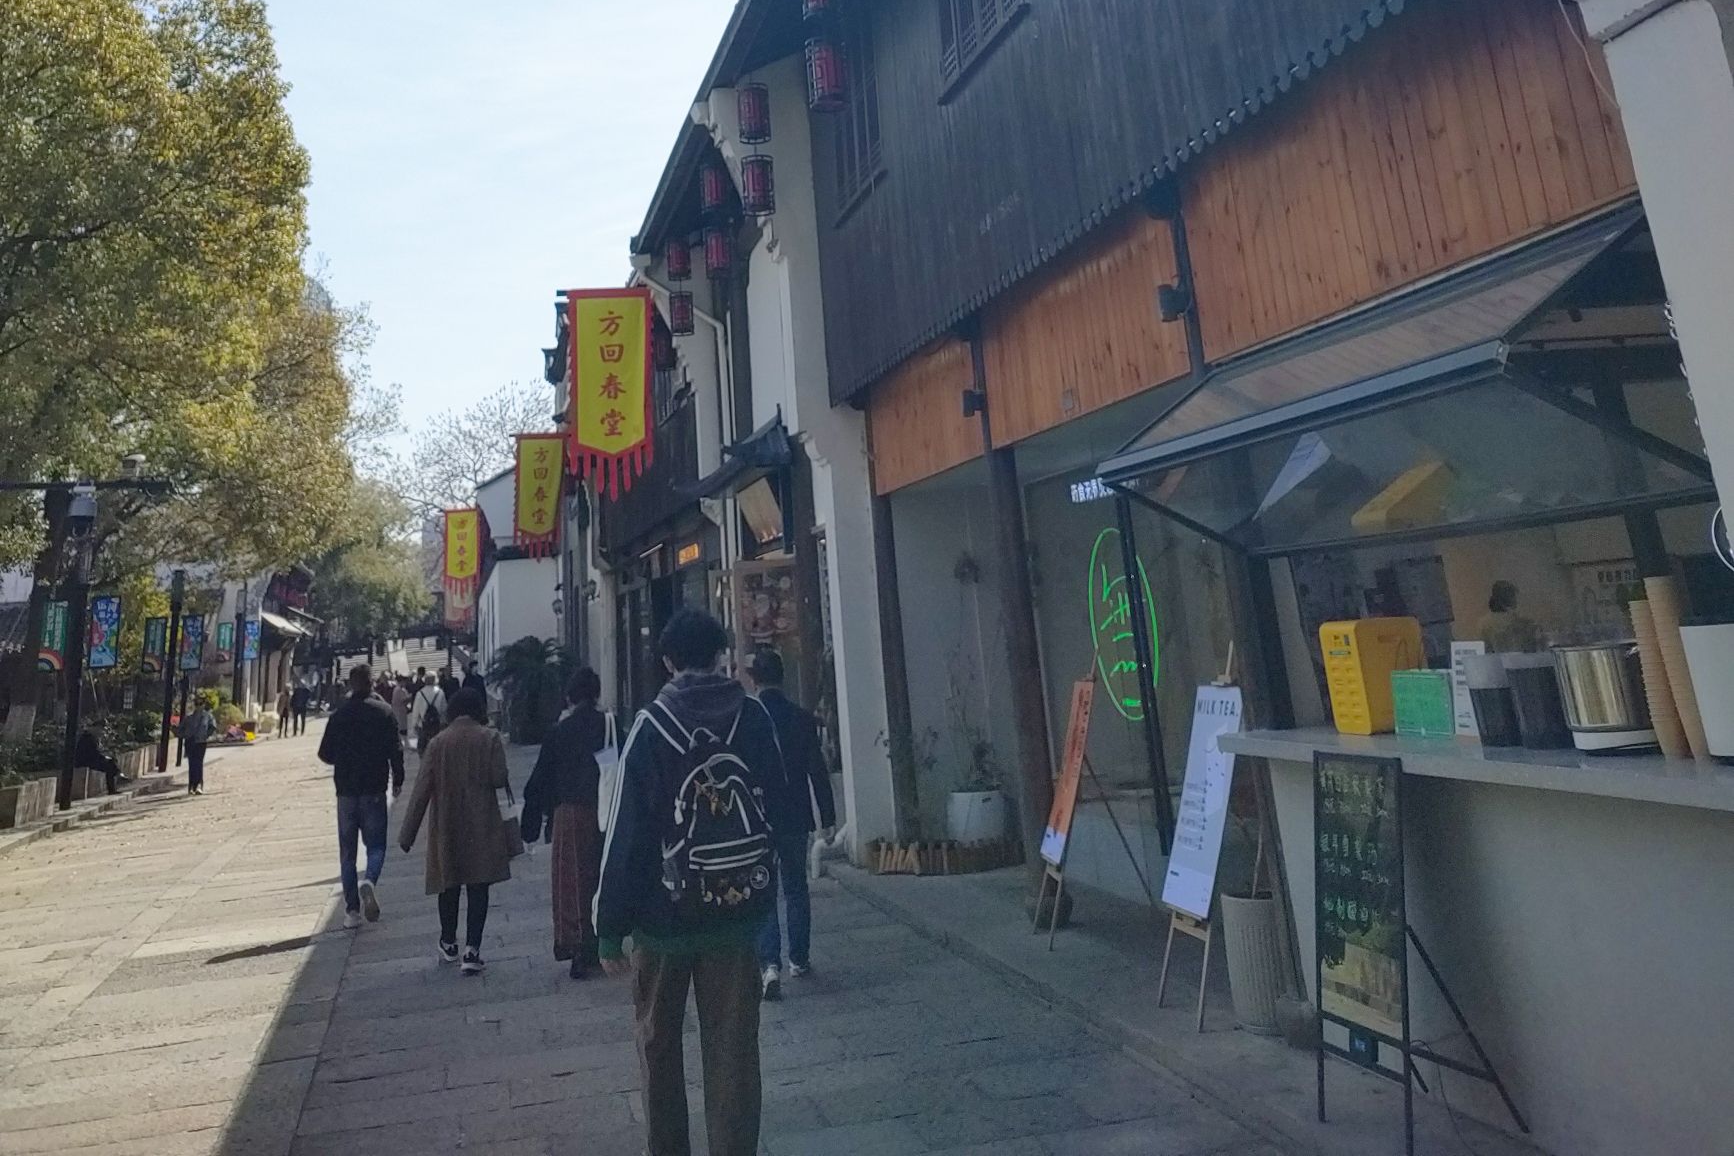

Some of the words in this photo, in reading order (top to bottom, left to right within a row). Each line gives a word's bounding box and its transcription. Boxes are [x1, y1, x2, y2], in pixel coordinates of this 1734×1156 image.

[599, 311, 626, 437] 方回春堂
[532, 447, 550, 525] 方回春堂
[456, 518, 468, 572] 方回春堂
[1197, 700, 1217, 714] MILK
